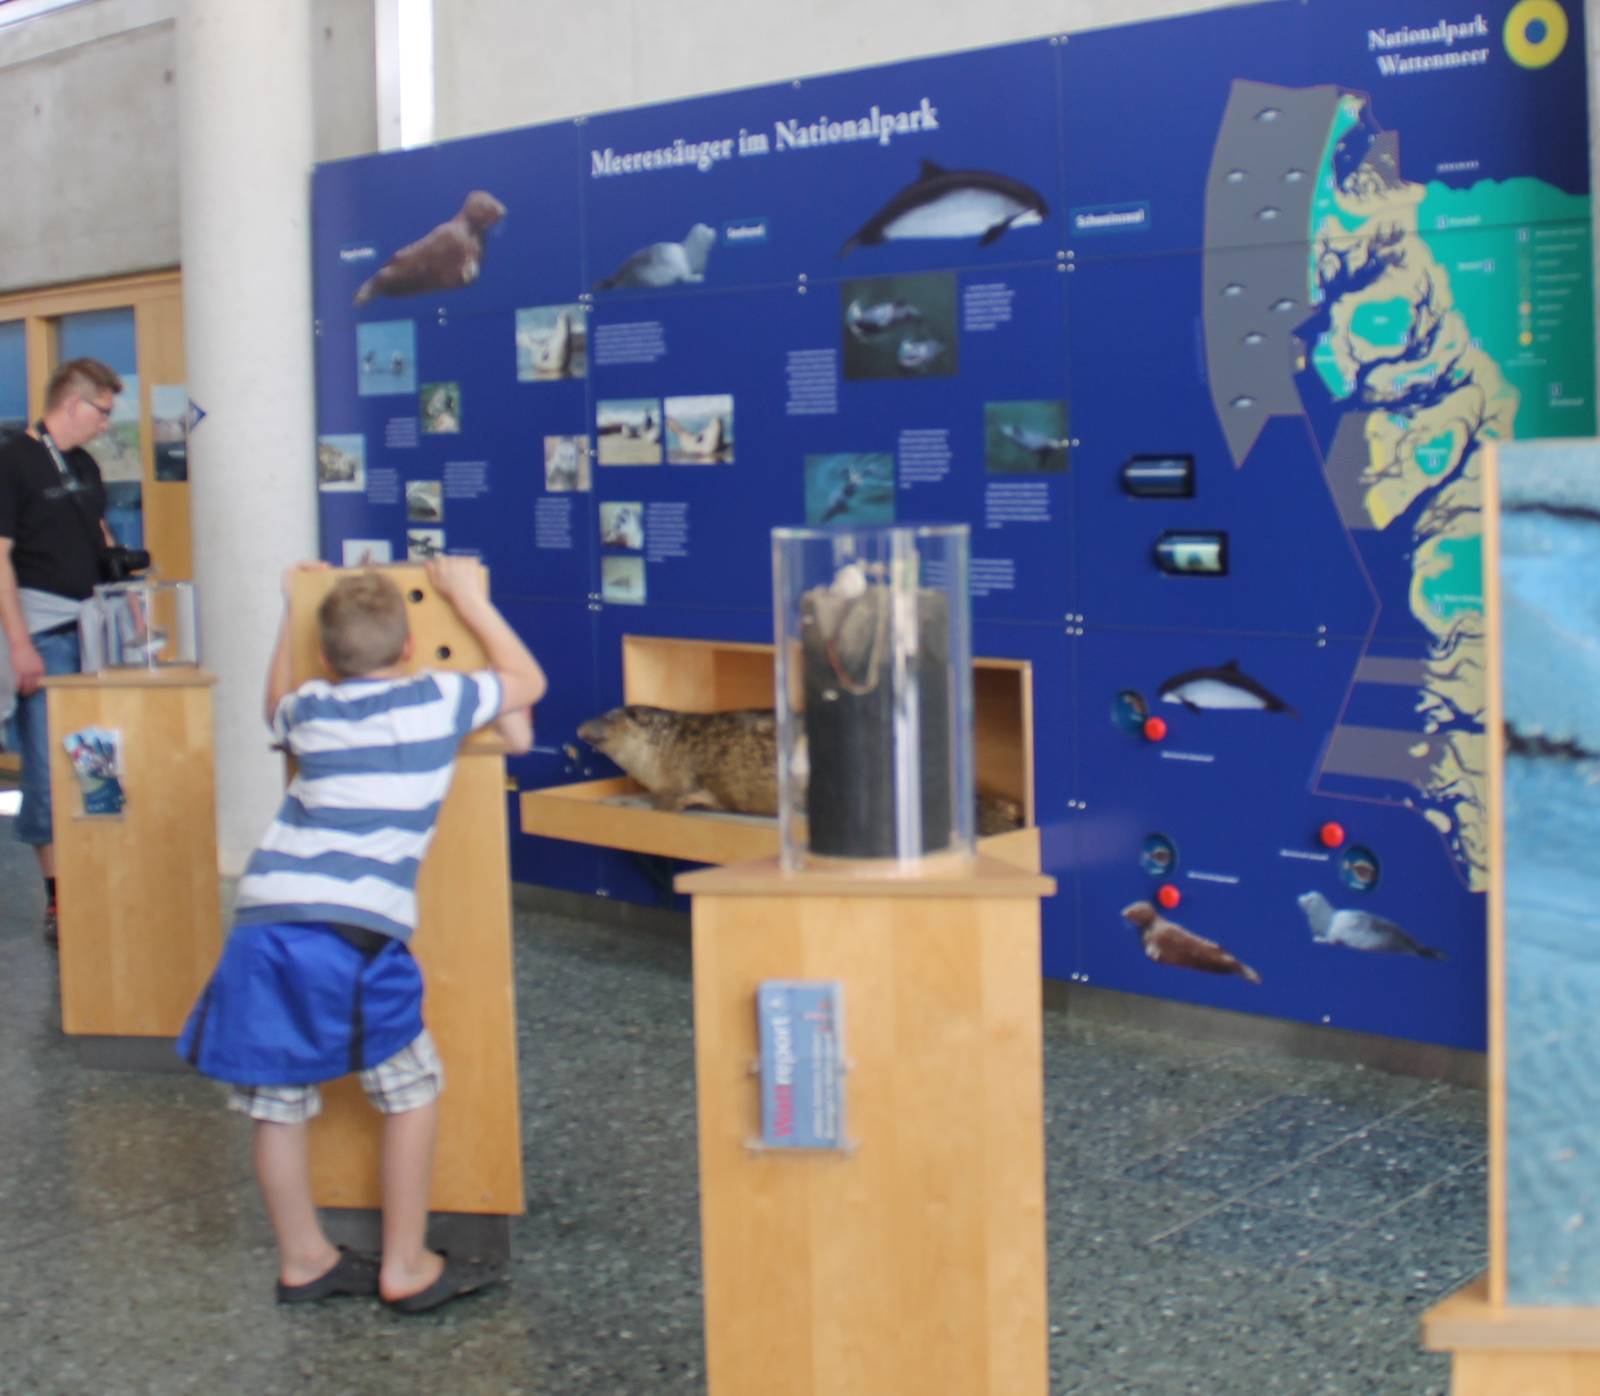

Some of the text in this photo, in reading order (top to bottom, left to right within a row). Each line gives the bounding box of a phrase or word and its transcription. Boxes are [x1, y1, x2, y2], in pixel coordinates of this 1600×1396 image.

[1368, 13, 1488, 51] Nationalpark
[1377, 48, 1489, 76] Wattenmeer
[591, 97, 939, 178] Meeressäuger im Nationalpark
